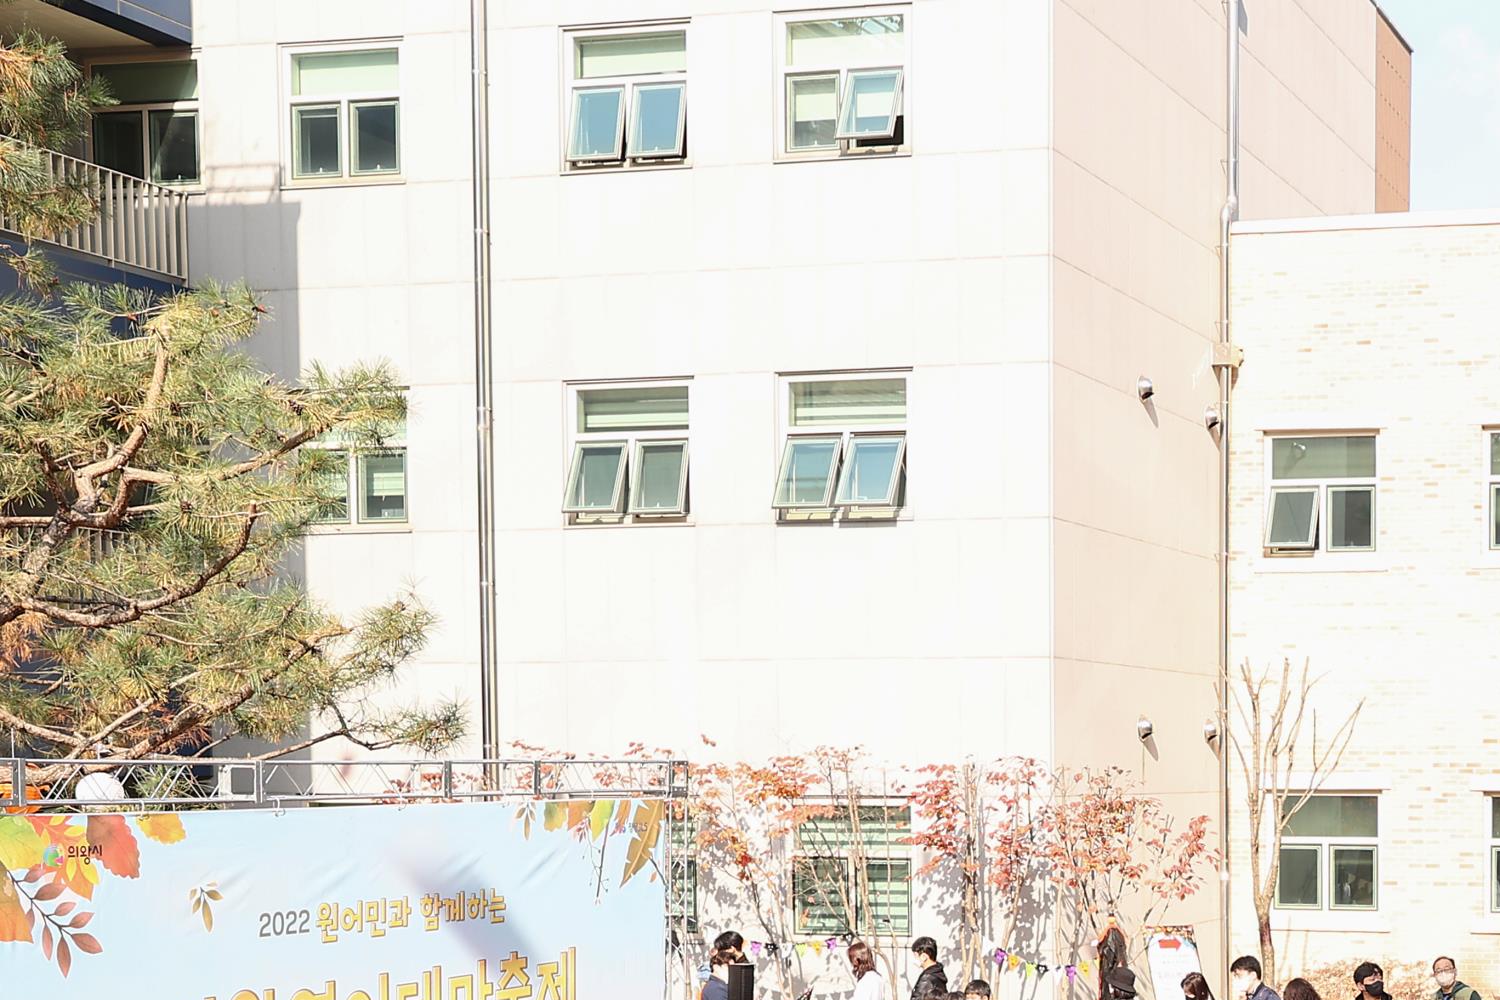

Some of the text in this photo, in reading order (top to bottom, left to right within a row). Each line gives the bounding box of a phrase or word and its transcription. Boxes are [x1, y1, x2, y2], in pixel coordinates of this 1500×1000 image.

[68, 844, 103, 865] 의왕시
[258, 888, 507, 944] 2022 원어민과 함께하는
